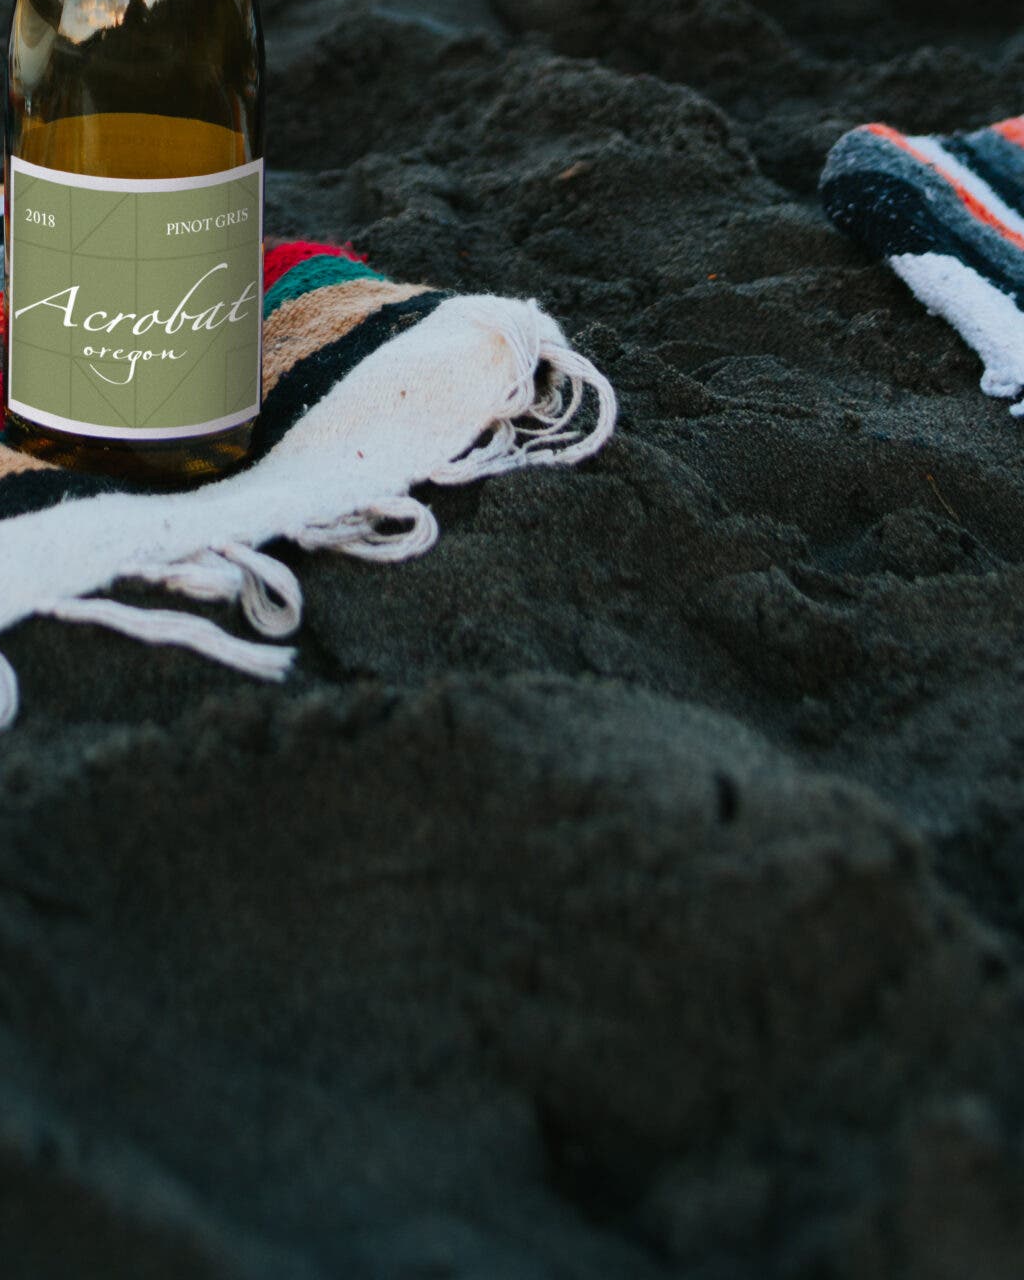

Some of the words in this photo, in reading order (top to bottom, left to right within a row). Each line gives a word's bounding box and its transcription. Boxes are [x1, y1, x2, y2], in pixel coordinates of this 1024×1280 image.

[25, 208, 56, 228] 2018
[166, 217, 213, 236] PINOT
[215, 207, 249, 228] GRIS
[14, 262, 257, 336] Acrobat
[83, 345, 187, 385] oregon
